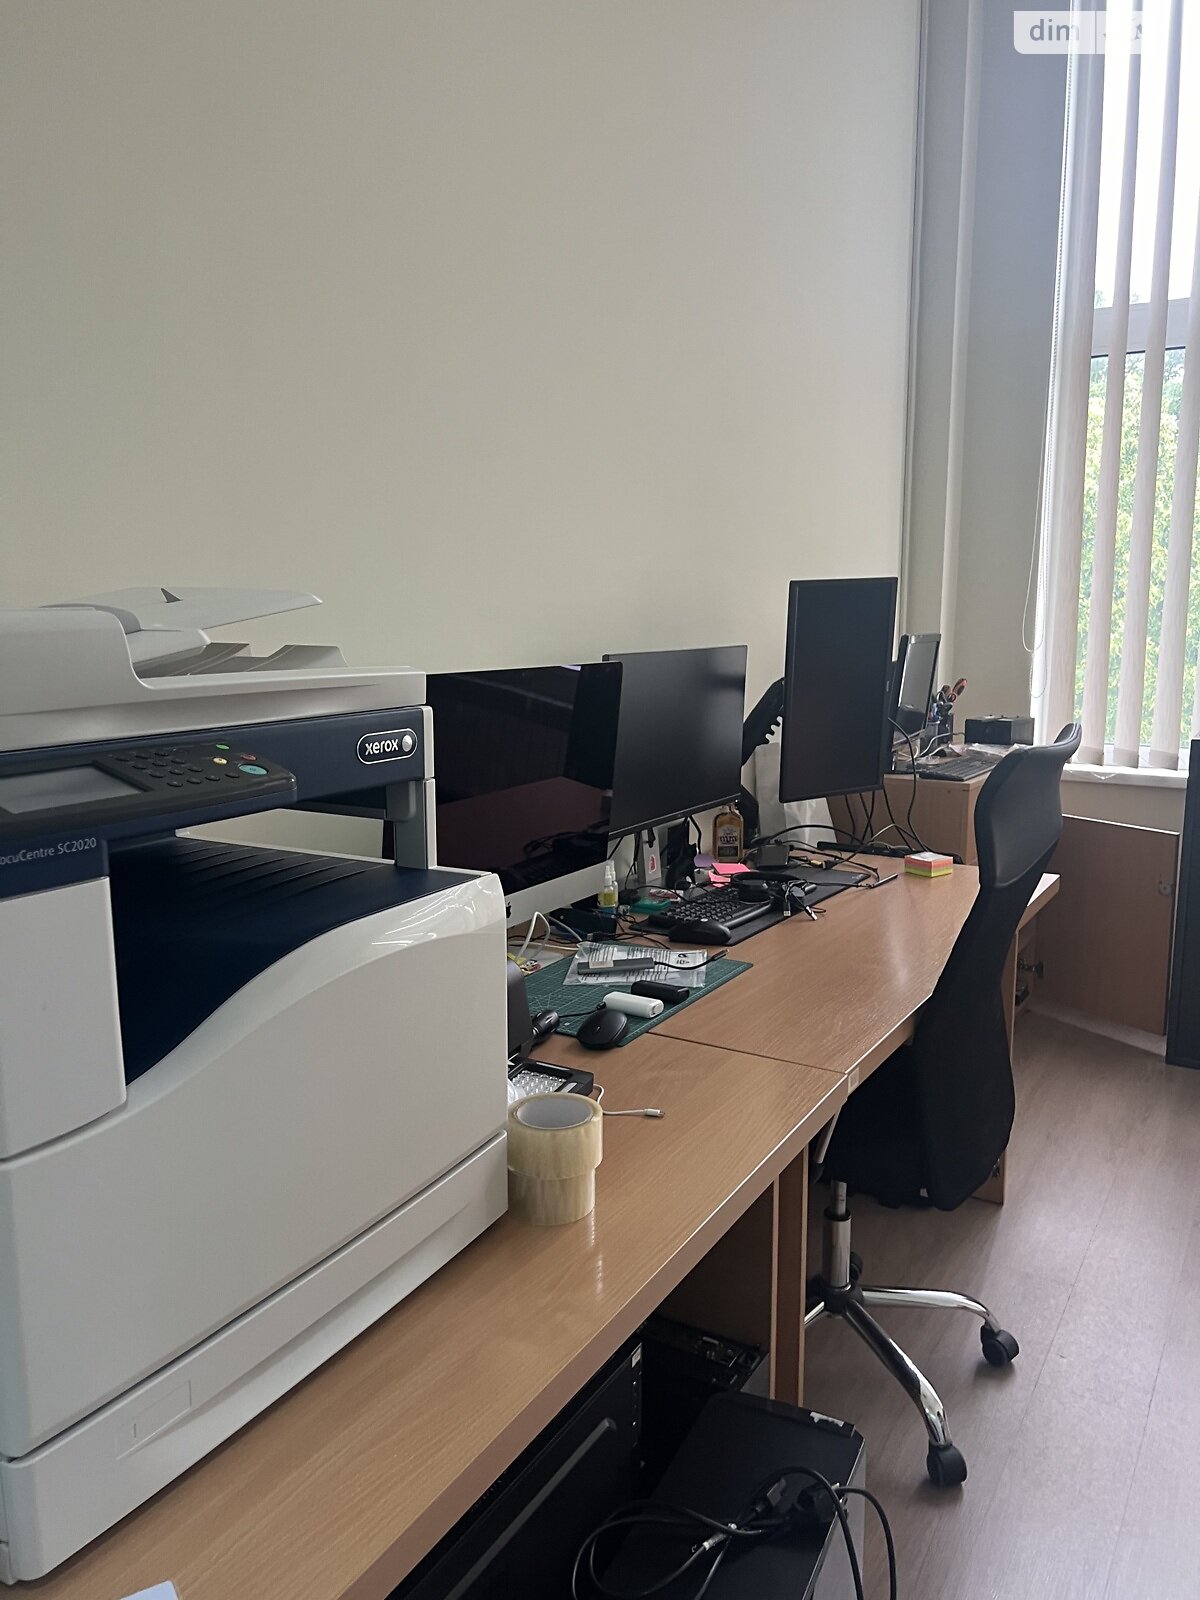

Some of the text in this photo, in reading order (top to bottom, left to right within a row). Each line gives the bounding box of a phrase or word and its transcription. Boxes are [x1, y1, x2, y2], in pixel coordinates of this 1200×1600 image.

[365, 738, 399, 756] xerox
[0, 837, 97, 865] ocuCentre SC2020
